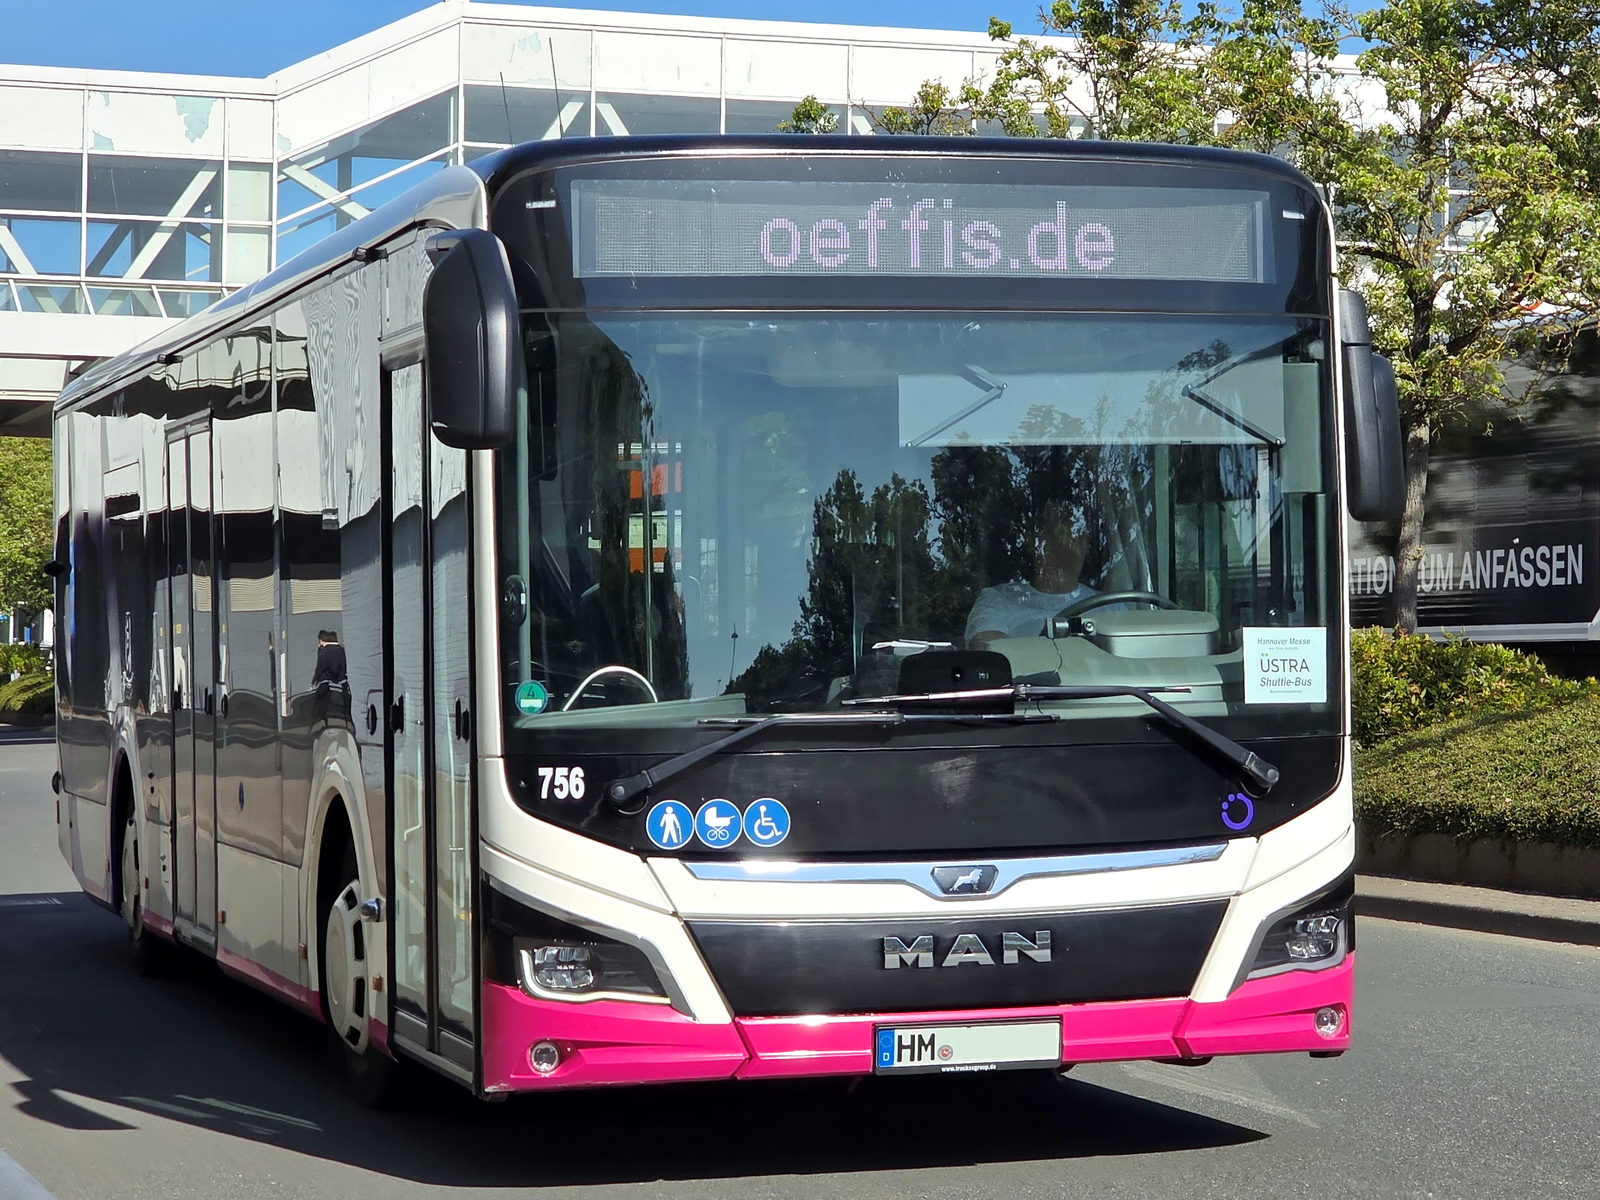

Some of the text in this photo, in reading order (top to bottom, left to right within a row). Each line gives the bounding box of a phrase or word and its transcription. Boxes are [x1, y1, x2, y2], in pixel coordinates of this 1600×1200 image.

[760, 197, 1115, 271] oeffis.de
[1459, 544, 1583, 589] ANFASSEN
[1257, 637, 1288, 645] Hannover
[1260, 652, 1310, 673] ÜSTRA
[527, 685, 535, 699] 4
[1260, 676, 1312, 687] Shuttle-Bus
[538, 766, 585, 801] 756
[883, 930, 1052, 970] MAN
[882, 1053, 890, 1062] D
[897, 1033, 936, 1063] HM
